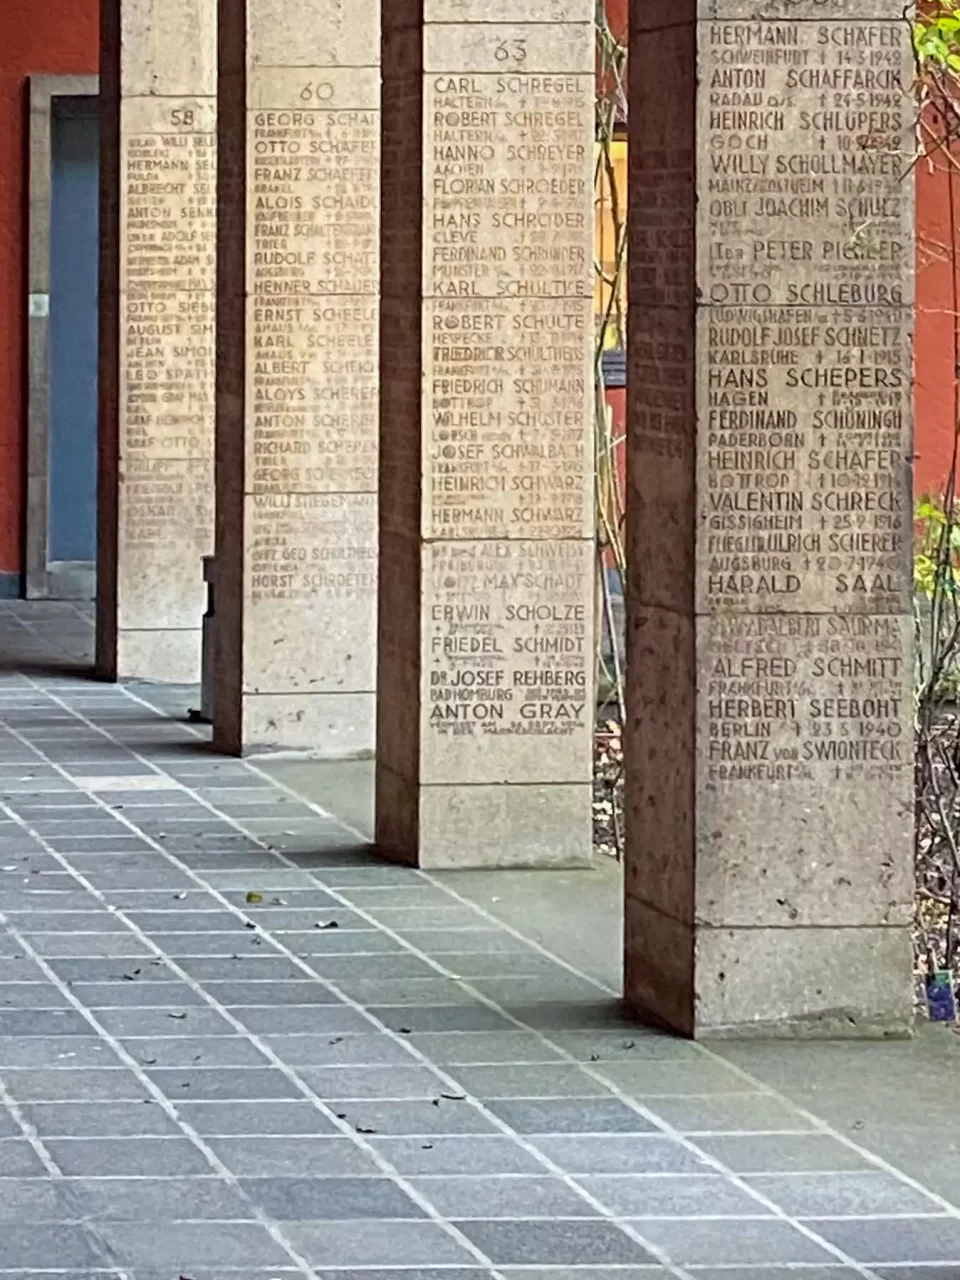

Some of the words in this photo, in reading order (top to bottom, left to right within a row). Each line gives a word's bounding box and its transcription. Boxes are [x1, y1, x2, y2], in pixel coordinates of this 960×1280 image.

[710, 26, 798, 46] HERMANN
[494, 38, 527, 62] 63
[433, 77, 482, 94] CARL
[496, 77, 585, 94] SCHREGEL
[710, 70, 766, 89] ANTON
[300, 81, 335, 101] 60
[170, 109, 195, 126] 58
[254, 113, 315, 126] GEORG
[433, 111, 497, 127] ROBERT
[504, 111, 585, 128] SCHREGEL
[709, 111, 784, 131] HEINRICH
[254, 140, 301, 154] OTTO
[710, 135, 768, 150] GOCH
[433, 145, 495, 161] HANNO
[507, 145, 585, 161] SCHREYER
[127, 160, 189, 171] HERMANN
[710, 155, 769, 175] WILLY
[776, 154, 902, 176] SCHOLLMAYER
[254, 168, 302, 181] FRANZ
[127, 183, 186, 195] ALBRECHT
[433, 178, 495, 195] FLORIAN
[500, 178, 585, 195] SCHROEDER
[254, 196, 303, 210] ALOIS
[755, 198, 829, 218] JOACHIM
[127, 207, 171, 218] ANTON
[432, 213, 481, 229] HANS
[432, 231, 478, 243] CLEVE
[254, 252, 316, 265] RUDOLF
[432, 247, 506, 262] FERDINAND
[753, 241, 813, 261] PETER
[432, 280, 481, 296] KARL
[709, 283, 772, 303] OTTO
[785, 283, 903, 304] SCHLEBURG
[126, 302, 167, 314] OTTO
[254, 308, 303, 322] ERNST
[126, 324, 181, 336] AUGUST
[432, 314, 506, 330] ROBERT
[512, 314, 585, 330] SCHULTE
[254, 336, 295, 348] KARL
[709, 327, 771, 347] RUDOLF
[773, 327, 821, 347] JOSEF
[824, 326, 901, 347] SCHNETZ
[709, 350, 799, 365] KARLSRUHE
[254, 361, 310, 374] ALBERT
[708, 369, 768, 388] HANS
[785, 368, 903, 388] SCHEPERS
[254, 387, 306, 401] ALOYS
[432, 379, 503, 394] FRIEDRICH
[708, 391, 769, 407] HAGEN
[254, 415, 305, 427] ANTON
[432, 411, 500, 427] WILHELM
[708, 410, 798, 430] FERDINAND
[253, 441, 312, 454] RICHARD
[708, 433, 805, 448] PADERBORN
[431, 444, 485, 460] JOSEF
[708, 450, 795, 470] HEINRICH
[431, 475, 505, 491] HEINRICH
[511, 475, 584, 491] SCHWARZ
[708, 473, 790, 488] BOTTROP
[709, 491, 803, 512] VALENTIN
[811, 491, 902, 512] SCHRECK
[431, 508, 504, 523] HERMANN
[709, 515, 803, 530] GISSIGHEIM
[767, 533, 821, 553] ULRICH
[828, 533, 902, 553] SCHERER
[708, 556, 791, 572] AUGSBURG
[251, 574, 294, 588] HORST
[708, 574, 802, 594] HARALD
[835, 574, 902, 594] SAAL
[431, 604, 490, 621] ERWIN
[505, 604, 585, 621] SCHOLZE
[431, 636, 503, 653] FRIEDEL
[512, 636, 585, 653] SCHMIDT
[712, 657, 797, 678] ALFRED
[811, 657, 902, 678] SCHMITT
[450, 670, 505, 686] JOSEF
[513, 670, 586, 686] REHBERG
[430, 703, 504, 719] ANTON
[519, 703, 585, 719] GRAY
[709, 699, 796, 718] HERBERT
[709, 722, 771, 738] BERLIN
[709, 740, 769, 761] FRANZ
